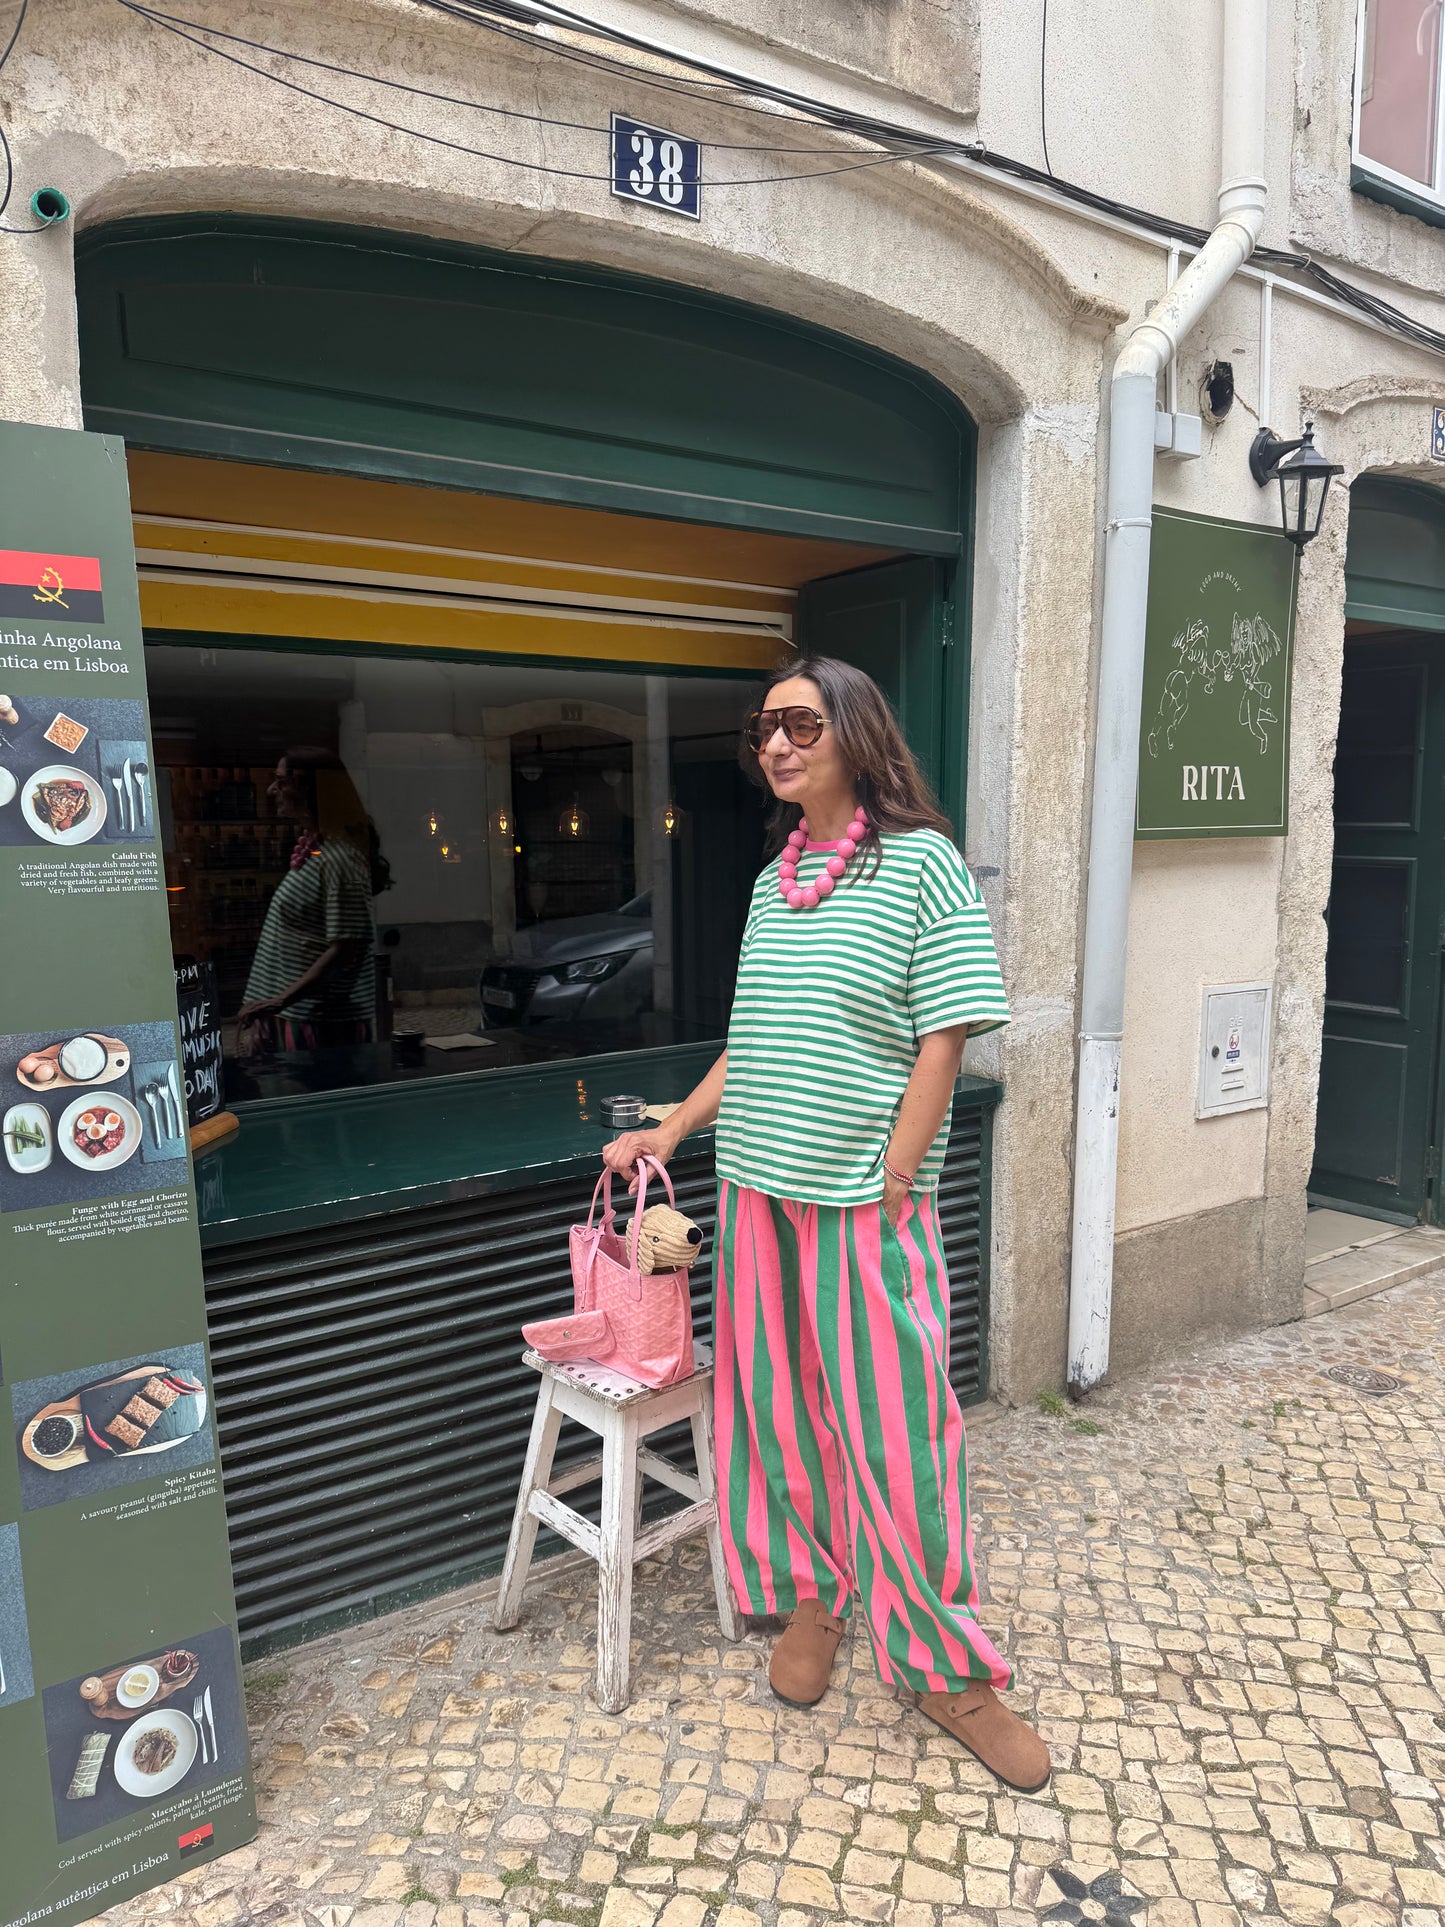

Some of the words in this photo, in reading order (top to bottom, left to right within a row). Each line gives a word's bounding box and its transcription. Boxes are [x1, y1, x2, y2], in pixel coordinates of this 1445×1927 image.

[629, 130, 684, 205] 38
[1199, 574, 1212, 594] FOOD
[1213, 571, 1224, 579] AND
[1225, 572, 1242, 593] DRINK
[42, 633, 122, 652] Angolana
[44, 659, 70, 671] em
[75, 657, 129, 673] Lisboa
[1182, 765, 1245, 800] RITA
[70, 862, 100, 870] Angolan
[59, 878, 97, 887] vegetables
[115, 877, 132, 885] leafy
[180, 1001, 210, 1037] IVE
[182, 1030, 221, 1063] MUSIC
[13, 1224, 34, 1233] Thick
[36, 1220, 57, 1231] purée
[59, 1217, 79, 1226] made
[80, 1214, 98, 1222] from
[100, 1210, 119, 1220] white
[121, 1206, 153, 1216] cornmeal
[164, 1200, 188, 1209] cassava
[72, 1206, 99, 1215] Funge
[101, 1202, 120, 1210] with
[122, 1199, 138, 1208] Egg
[140, 1196, 155, 1204] and
[157, 1192, 187, 1201] Chorizo
[47, 1227, 67, 1236] flour,
[68, 1224, 91, 1233] served
[93, 1220, 109, 1228] with
[111, 1216, 132, 1226] boiled
[134, 1214, 147, 1223] egg
[161, 1208, 189, 1217] chorizo,
[59, 1230, 106, 1243] accompanied
[108, 1227, 116, 1237] by
[118, 1222, 152, 1233] vegetables
[154, 1218, 167, 1226] and
[168, 1215, 190, 1223] beans.
[165, 1475, 187, 1487] Spicy
[189, 1468, 216, 1480] Kitaba
[89, 1505, 119, 1518] savoury
[120, 1497, 145, 1510] peanut
[147, 1486, 182, 1502] (ginguba)
[184, 1478, 217, 1492] appetiser.
[116, 1506, 150, 1520] seasoned
[151, 1501, 167, 1510] with
[169, 1496, 181, 1505] salt
[183, 1492, 196, 1501] and
[198, 1487, 218, 1496] chilli.
[151, 1799, 193, 1820] Macayabo
[201, 1776, 243, 1798] Luandense
[190, 1809, 207, 1820] kale,
[209, 1802, 222, 1812] and
[223, 1793, 245, 1807] funge.
[58, 1856, 75, 1869] Cod
[77, 1844, 103, 1862] served
[104, 1837, 122, 1849] with
[123, 1828, 143, 1843] spicy
[144, 1816, 172, 1831] onions,
[173, 1808, 191, 1822] palm
[192, 1801, 202, 1812] oil
[203, 1792, 226, 1806] beans,
[227, 1783, 244, 1795] fried
[55, 1880, 110, 1911] autêntica
[111, 1871, 130, 1884] em
[133, 1852, 169, 1875] Lisboa
